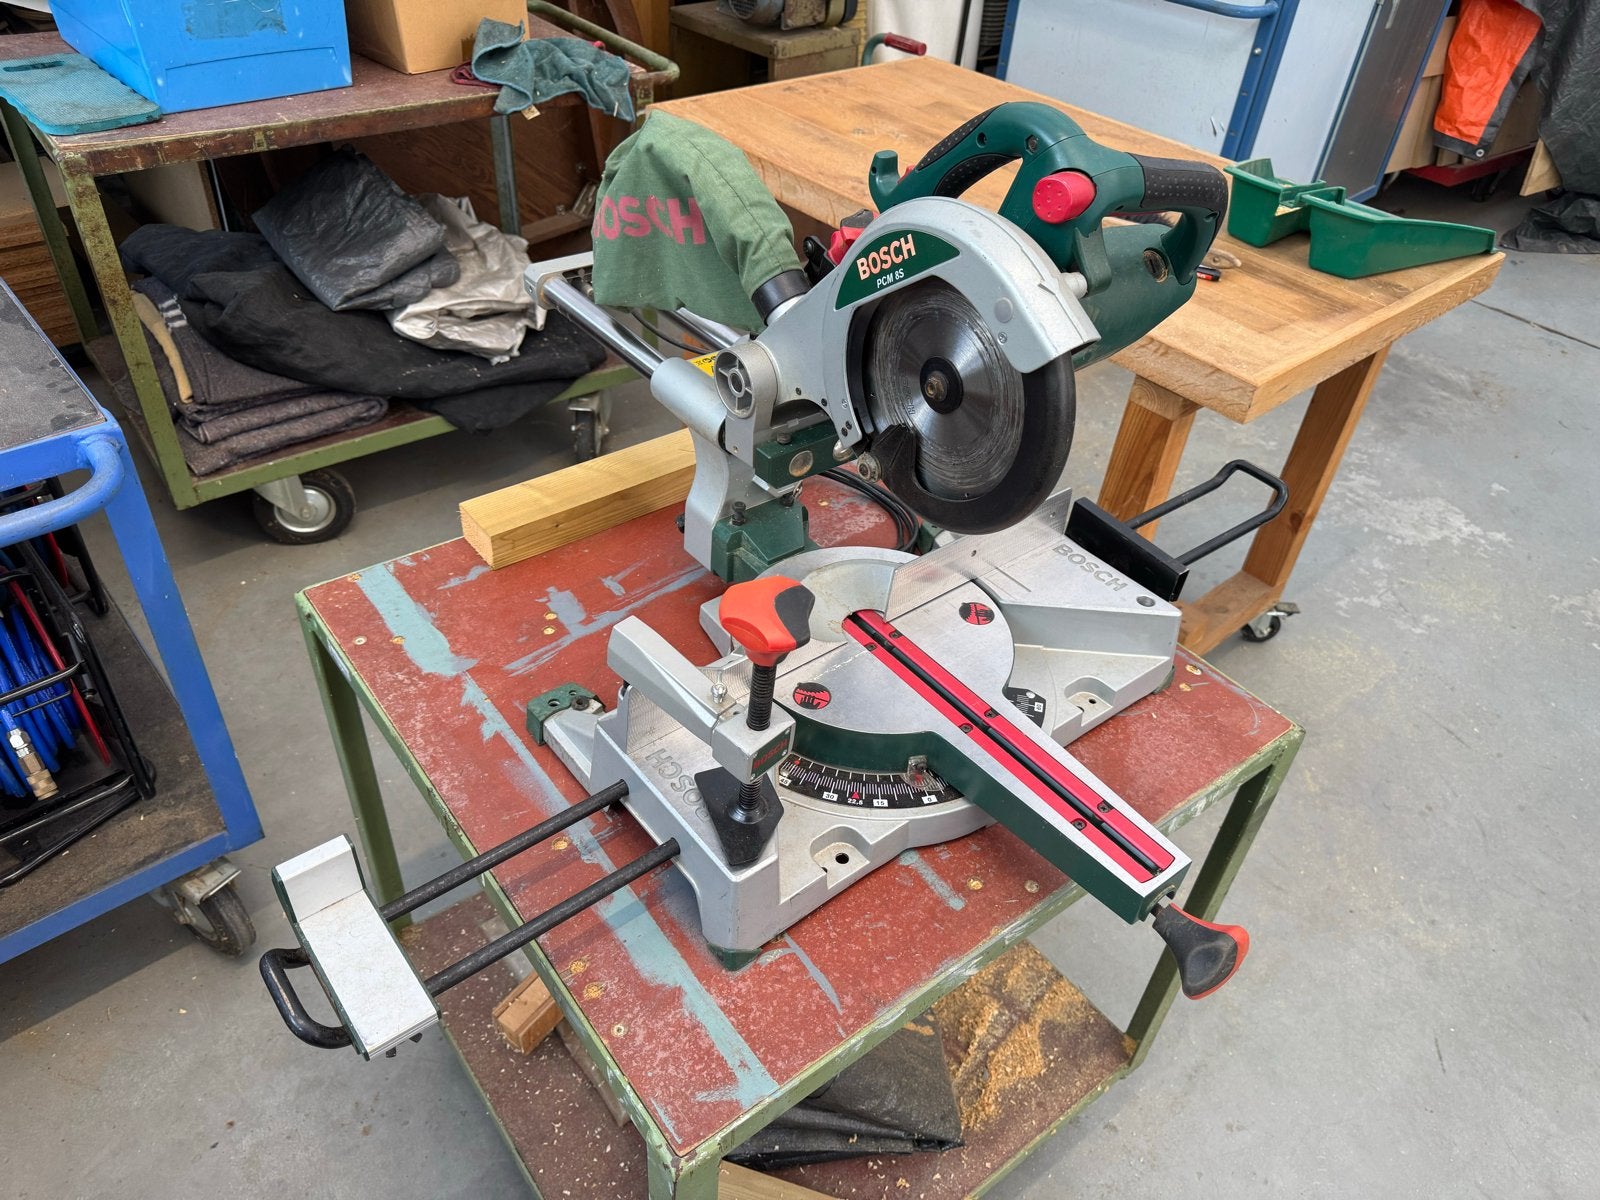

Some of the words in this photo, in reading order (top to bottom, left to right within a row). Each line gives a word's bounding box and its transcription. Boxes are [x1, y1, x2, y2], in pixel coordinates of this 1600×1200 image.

[856, 233, 916, 280] BOSCH
[876, 272, 894, 288] PCM
[894, 268, 905, 281] 8S
[1052, 543, 1129, 592] BOSCH
